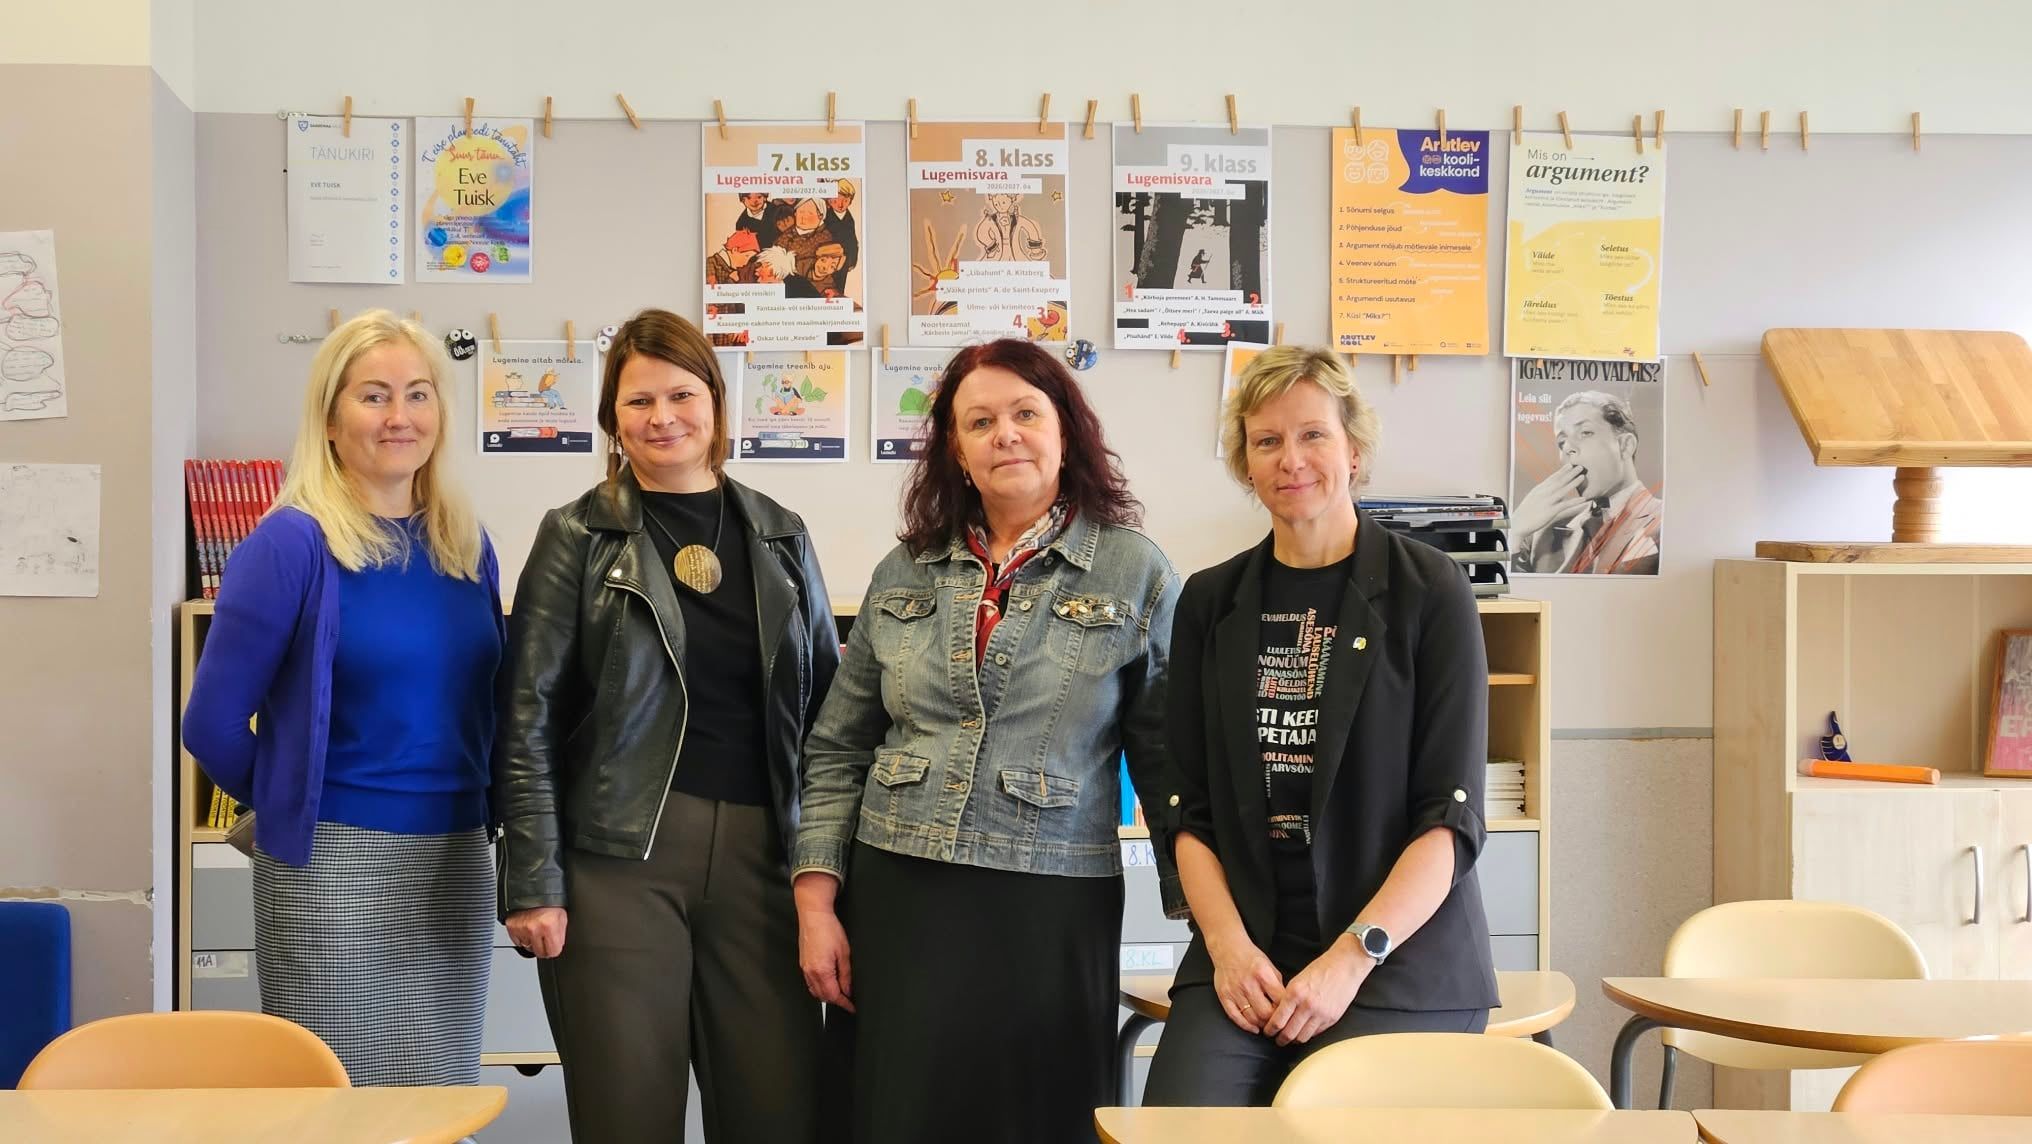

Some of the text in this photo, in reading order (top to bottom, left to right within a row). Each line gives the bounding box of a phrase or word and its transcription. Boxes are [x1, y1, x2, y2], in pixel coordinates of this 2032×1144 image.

[1420, 136, 1481, 152] Arutlev
[311, 144, 375, 160] TÄNUKIRI
[975, 148, 1054, 168] 8. klass
[1527, 148, 1567, 161] Mis on
[771, 152, 850, 172] 7. klass
[1180, 153, 1257, 173] 9. klass
[1443, 153, 1480, 165] kooli-
[458, 168, 487, 184] Eve
[922, 169, 1008, 184] Lugemisvara
[1420, 165, 1480, 178] keskkond
[1525, 163, 1650, 185] argument?
[716, 173, 804, 188] Lugemisvara
[1127, 173, 1213, 187] Lugemisvara
[453, 189, 495, 207] Tuisk
[1373, 207, 1395, 215] selgus
[1346, 242, 1380, 250] Argument
[1600, 244, 1629, 253] Seletus
[1532, 250, 1555, 260] Väide
[1346, 259, 1372, 267] Veenev
[1346, 277, 1397, 285] Struktureeritud
[1523, 299, 1557, 309] Järeldus
[1603, 293, 1634, 302] Tõestus
[492, 356, 529, 365] Lugemine
[531, 356, 553, 364] aitab
[747, 362, 784, 371] Lugemine
[787, 362, 816, 370] treenib
[884, 364, 921, 373] Lugemine
